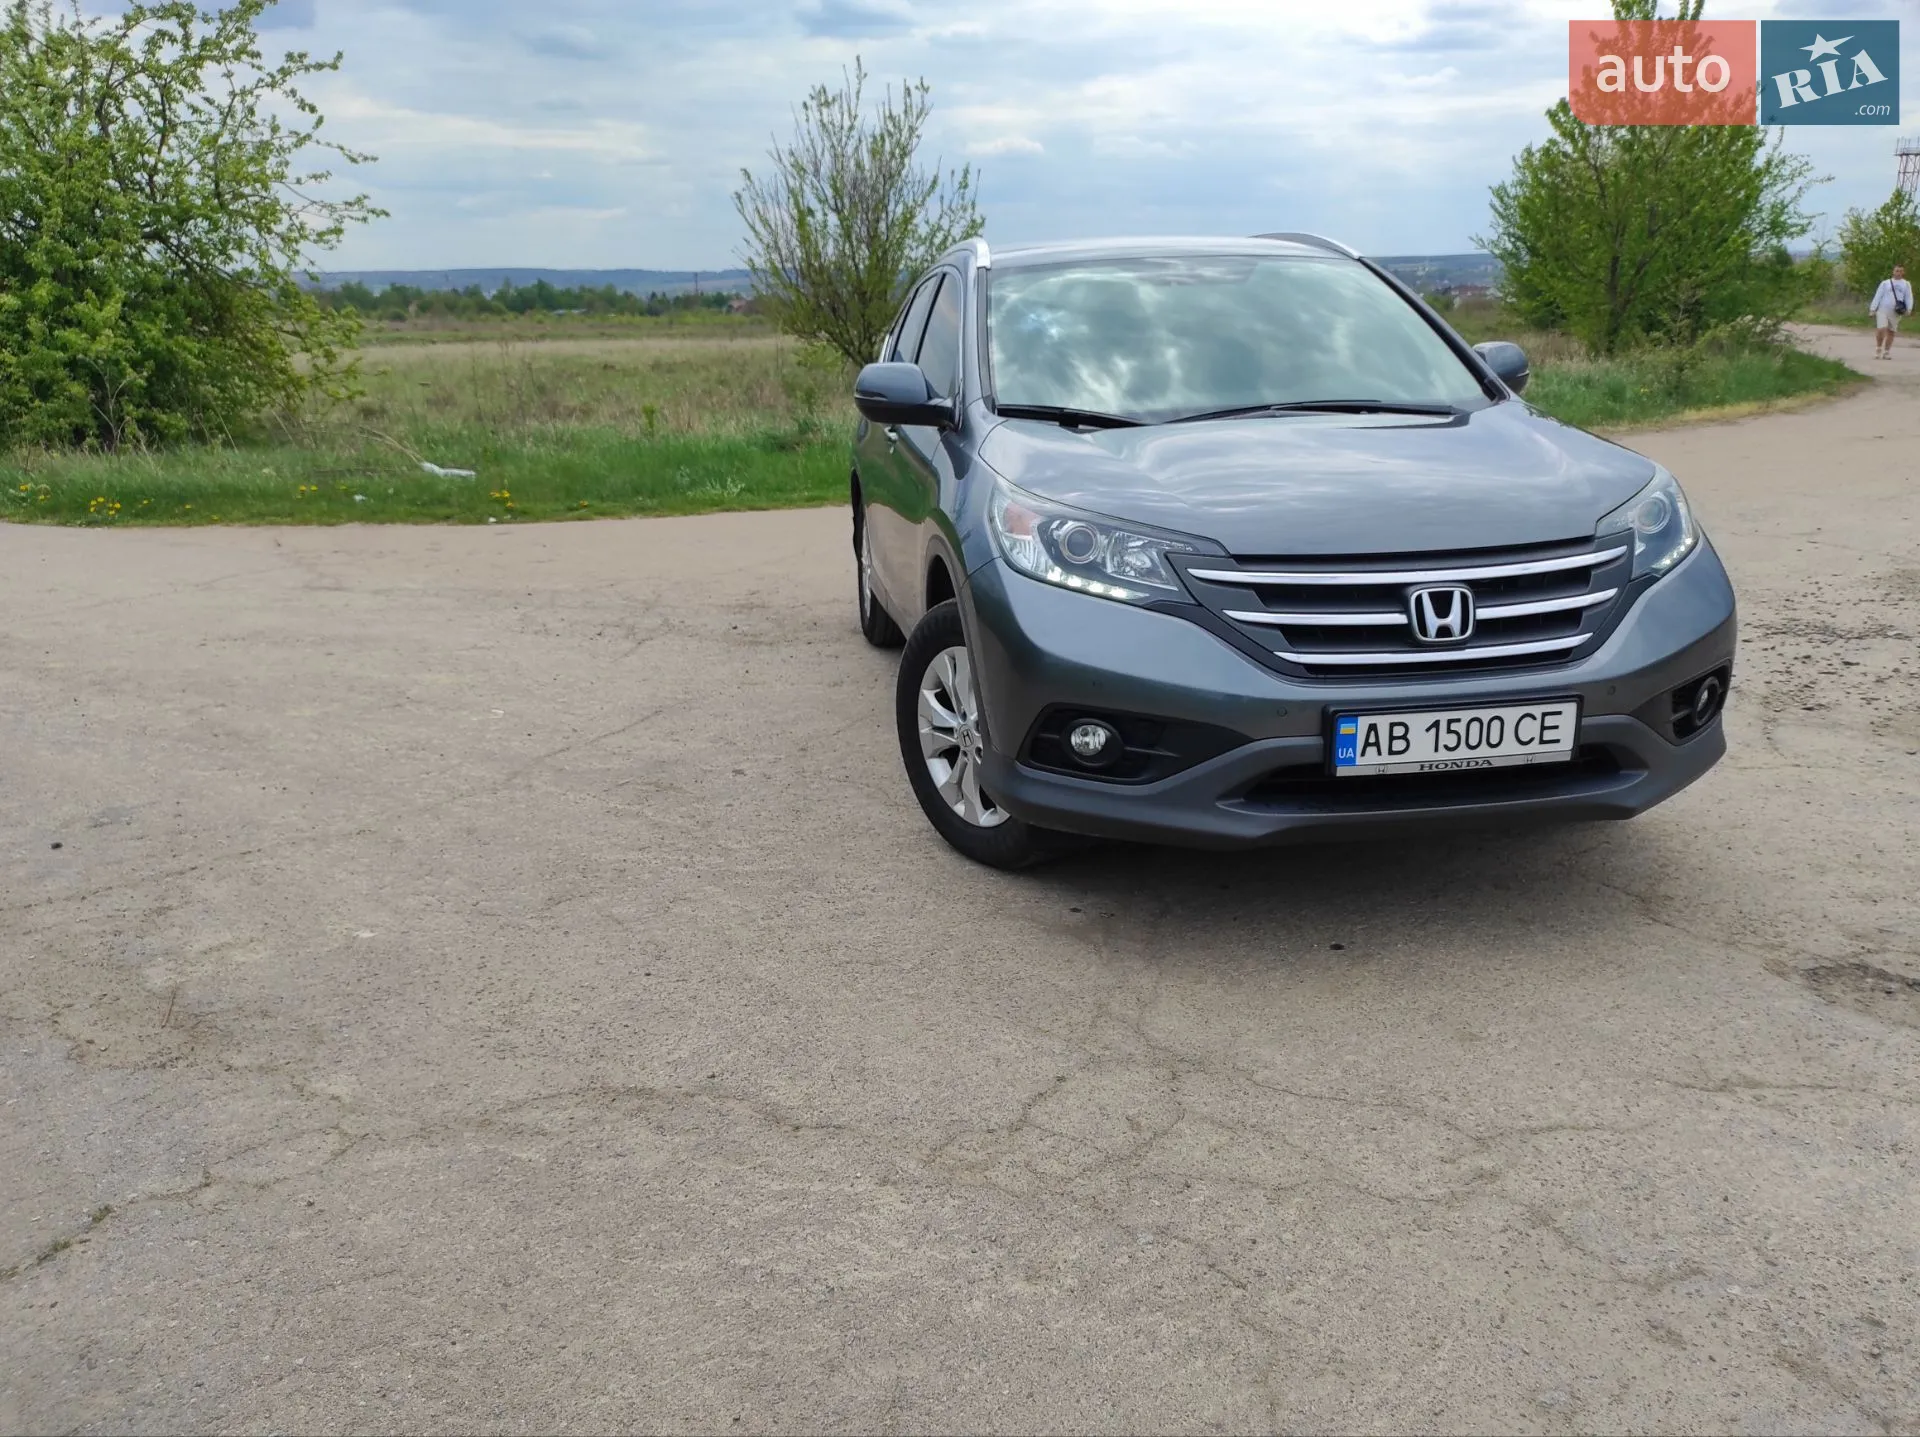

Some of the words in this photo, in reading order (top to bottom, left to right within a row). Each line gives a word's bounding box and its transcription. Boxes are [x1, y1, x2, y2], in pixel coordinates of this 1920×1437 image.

[1360, 721, 1410, 757] AB
[1425, 715, 1505, 753] 1500
[1514, 710, 1563, 746] CE
[1338, 747, 1355, 759] UA
[1419, 758, 1494, 772] HONDA
